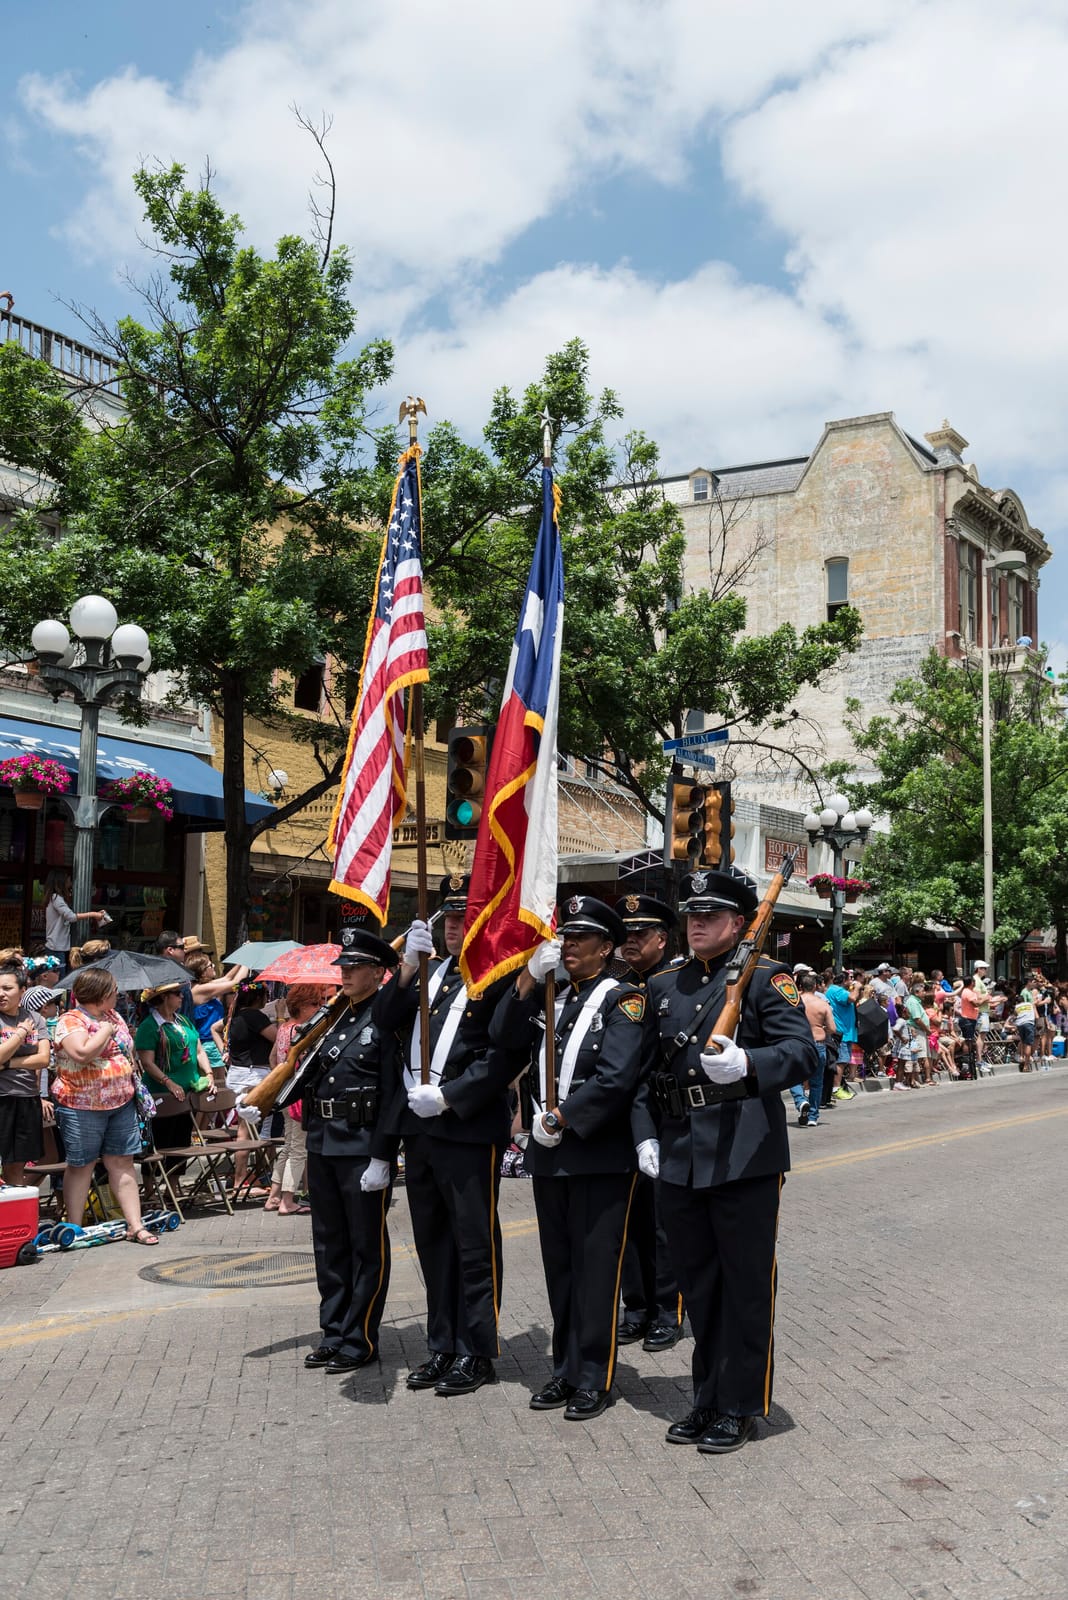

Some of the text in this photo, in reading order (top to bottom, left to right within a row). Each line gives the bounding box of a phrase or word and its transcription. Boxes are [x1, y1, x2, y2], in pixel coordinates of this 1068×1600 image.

[682, 734, 709, 748] BLUM
[676, 748, 697, 760] ALAMO
[402, 825, 438, 841] DRGS
[341, 903, 368, 916] Coors
[343, 915, 366, 923] LIGHT
